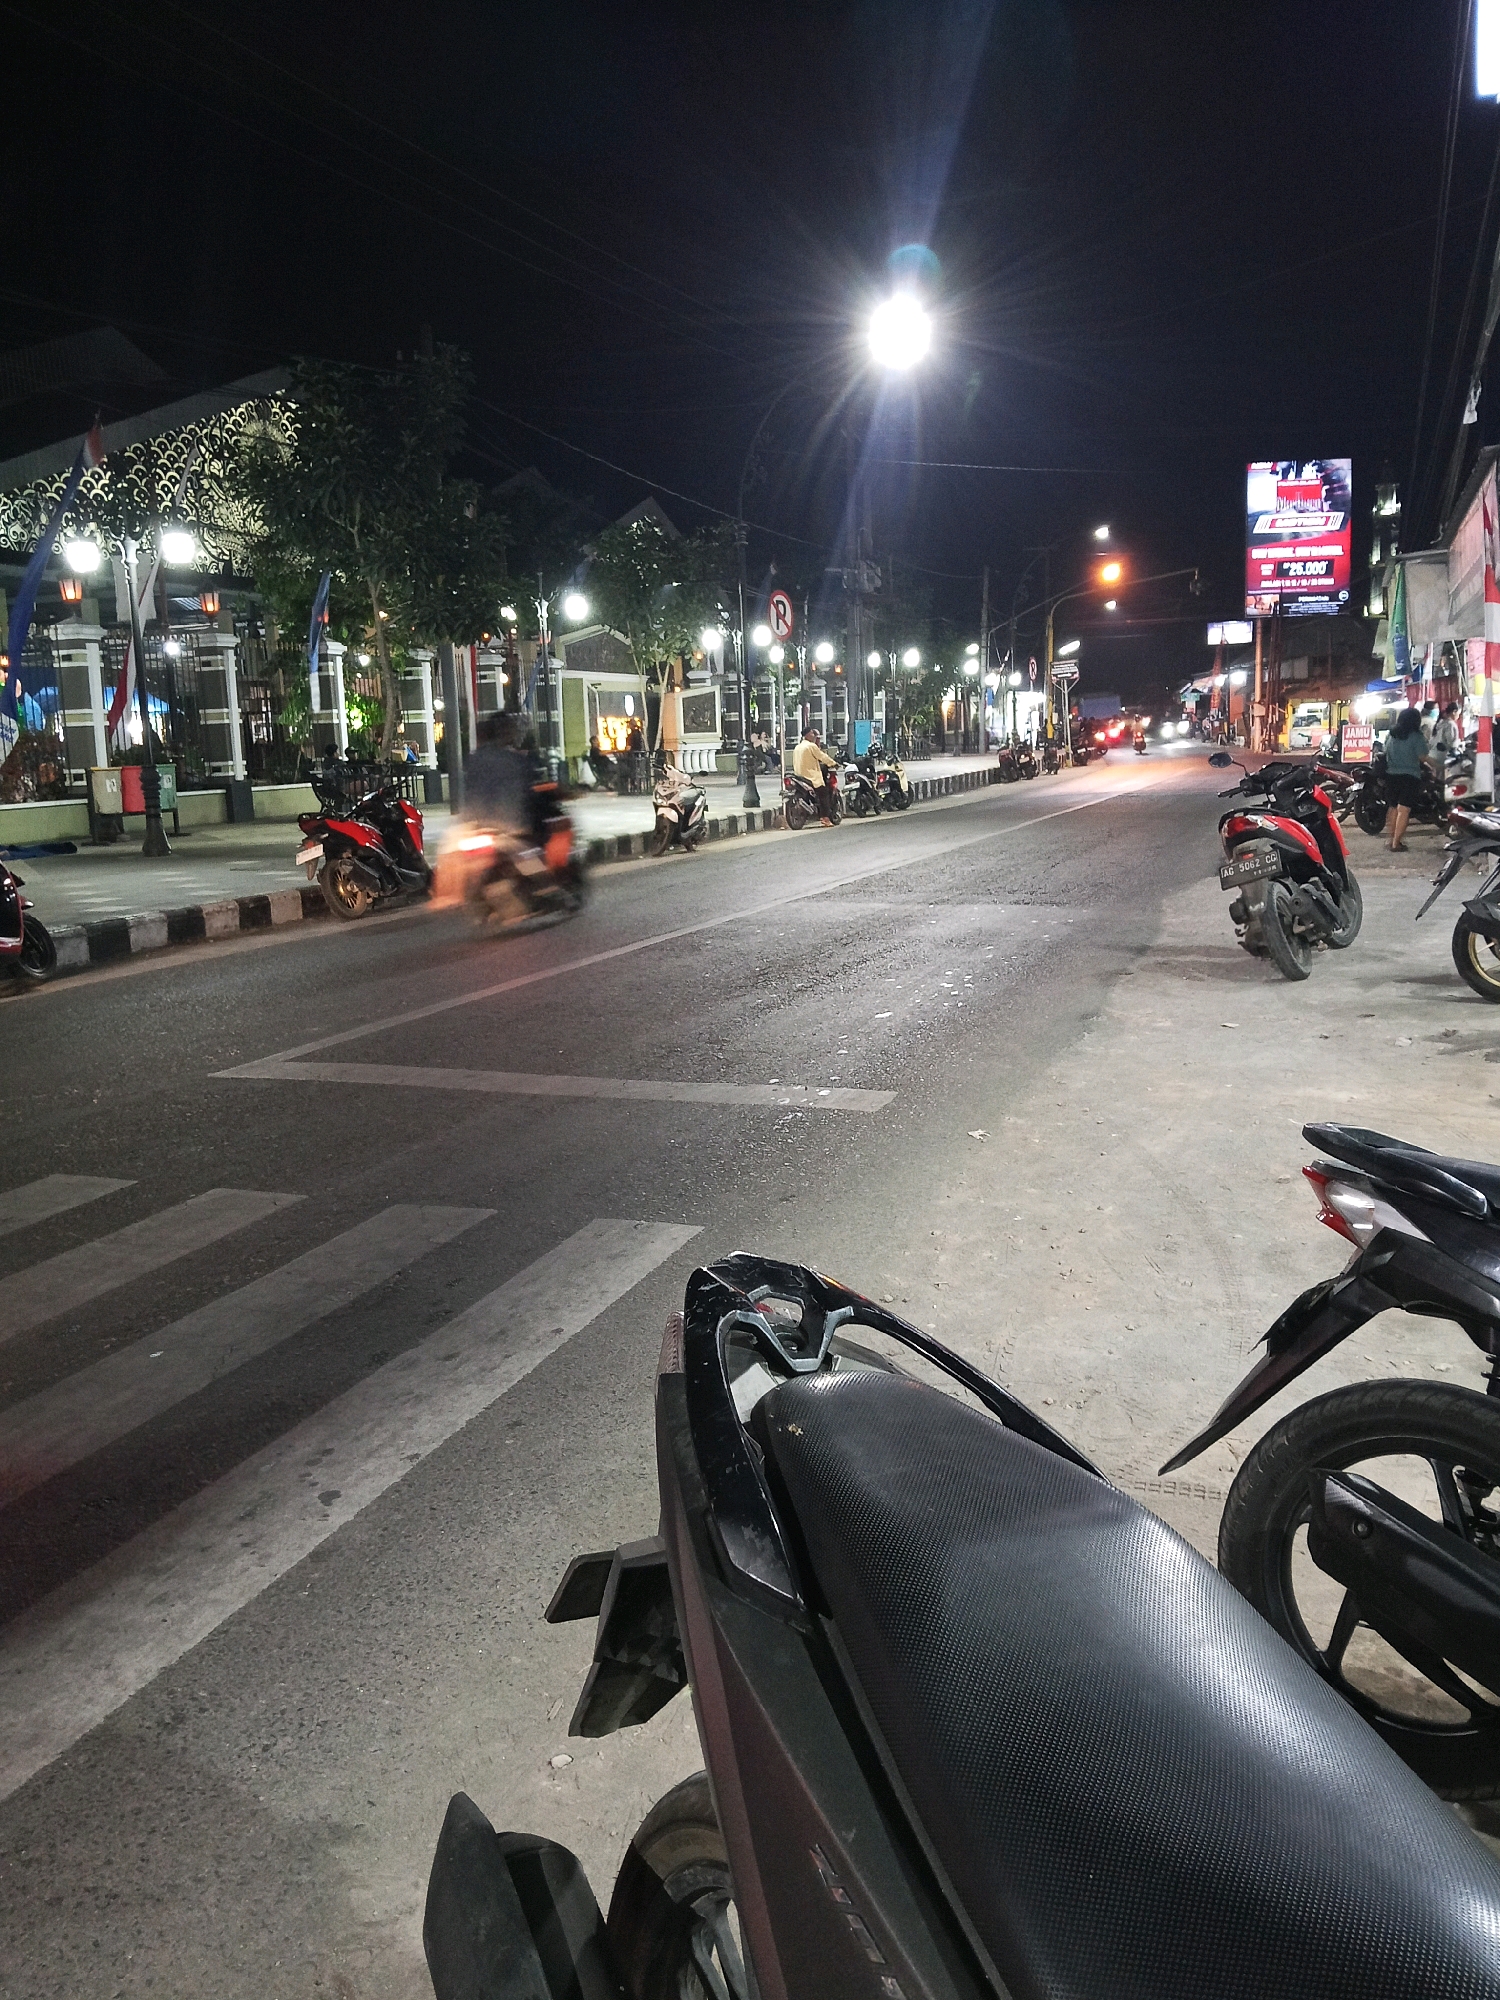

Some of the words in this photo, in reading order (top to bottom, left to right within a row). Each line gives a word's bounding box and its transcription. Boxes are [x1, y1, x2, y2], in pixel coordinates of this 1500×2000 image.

[1345, 727, 1370, 739] JAMU
[1344, 739, 1357, 748] PAK
[1358, 738, 1371, 748] DIN
[1224, 867, 1235, 878] AG
[1239, 858, 1261, 873] 5062
